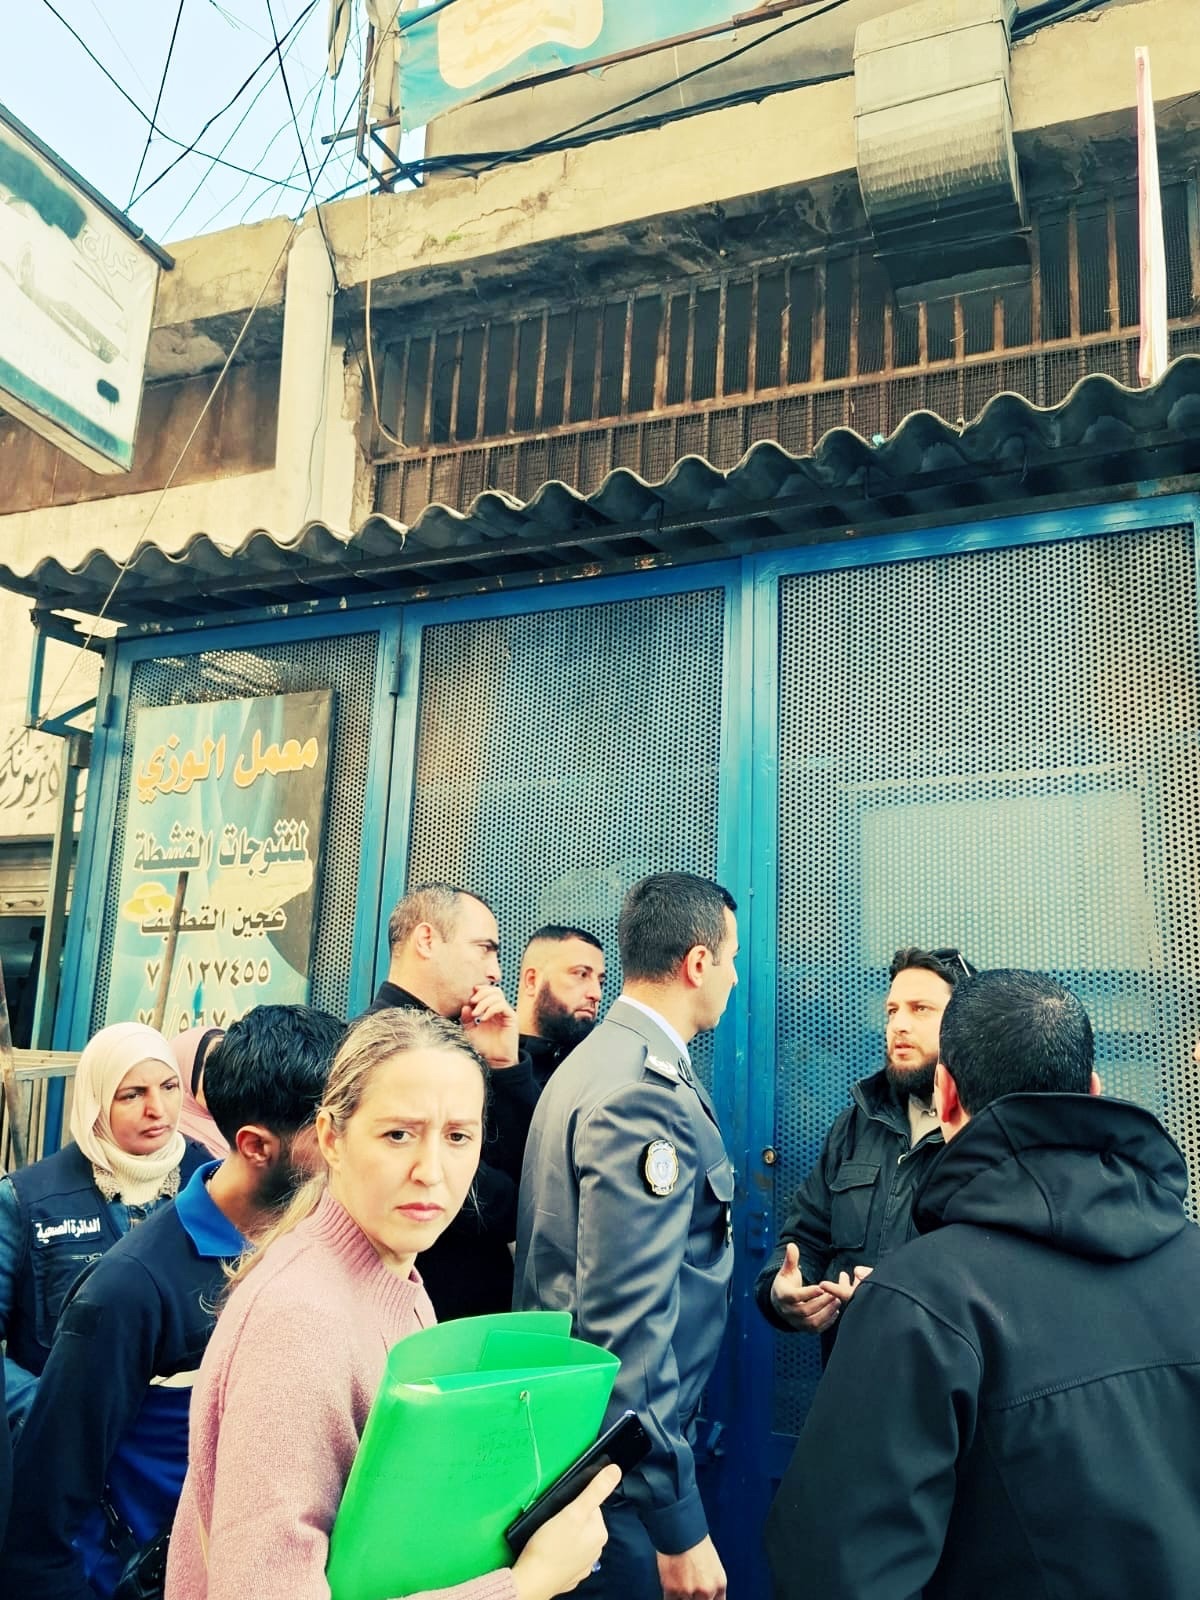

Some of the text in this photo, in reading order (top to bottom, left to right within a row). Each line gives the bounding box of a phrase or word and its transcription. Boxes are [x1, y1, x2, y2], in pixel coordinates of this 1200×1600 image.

[137, 734, 226, 803] الوزي
[234, 729, 318, 787] معمل
[133, 820, 213, 872] القشطة
[232, 907, 287, 938] عجين
[146, 958, 271, 994] ٧/١٢٧٤٥٥
[35, 1217, 101, 1244] الدائرة الصحية
